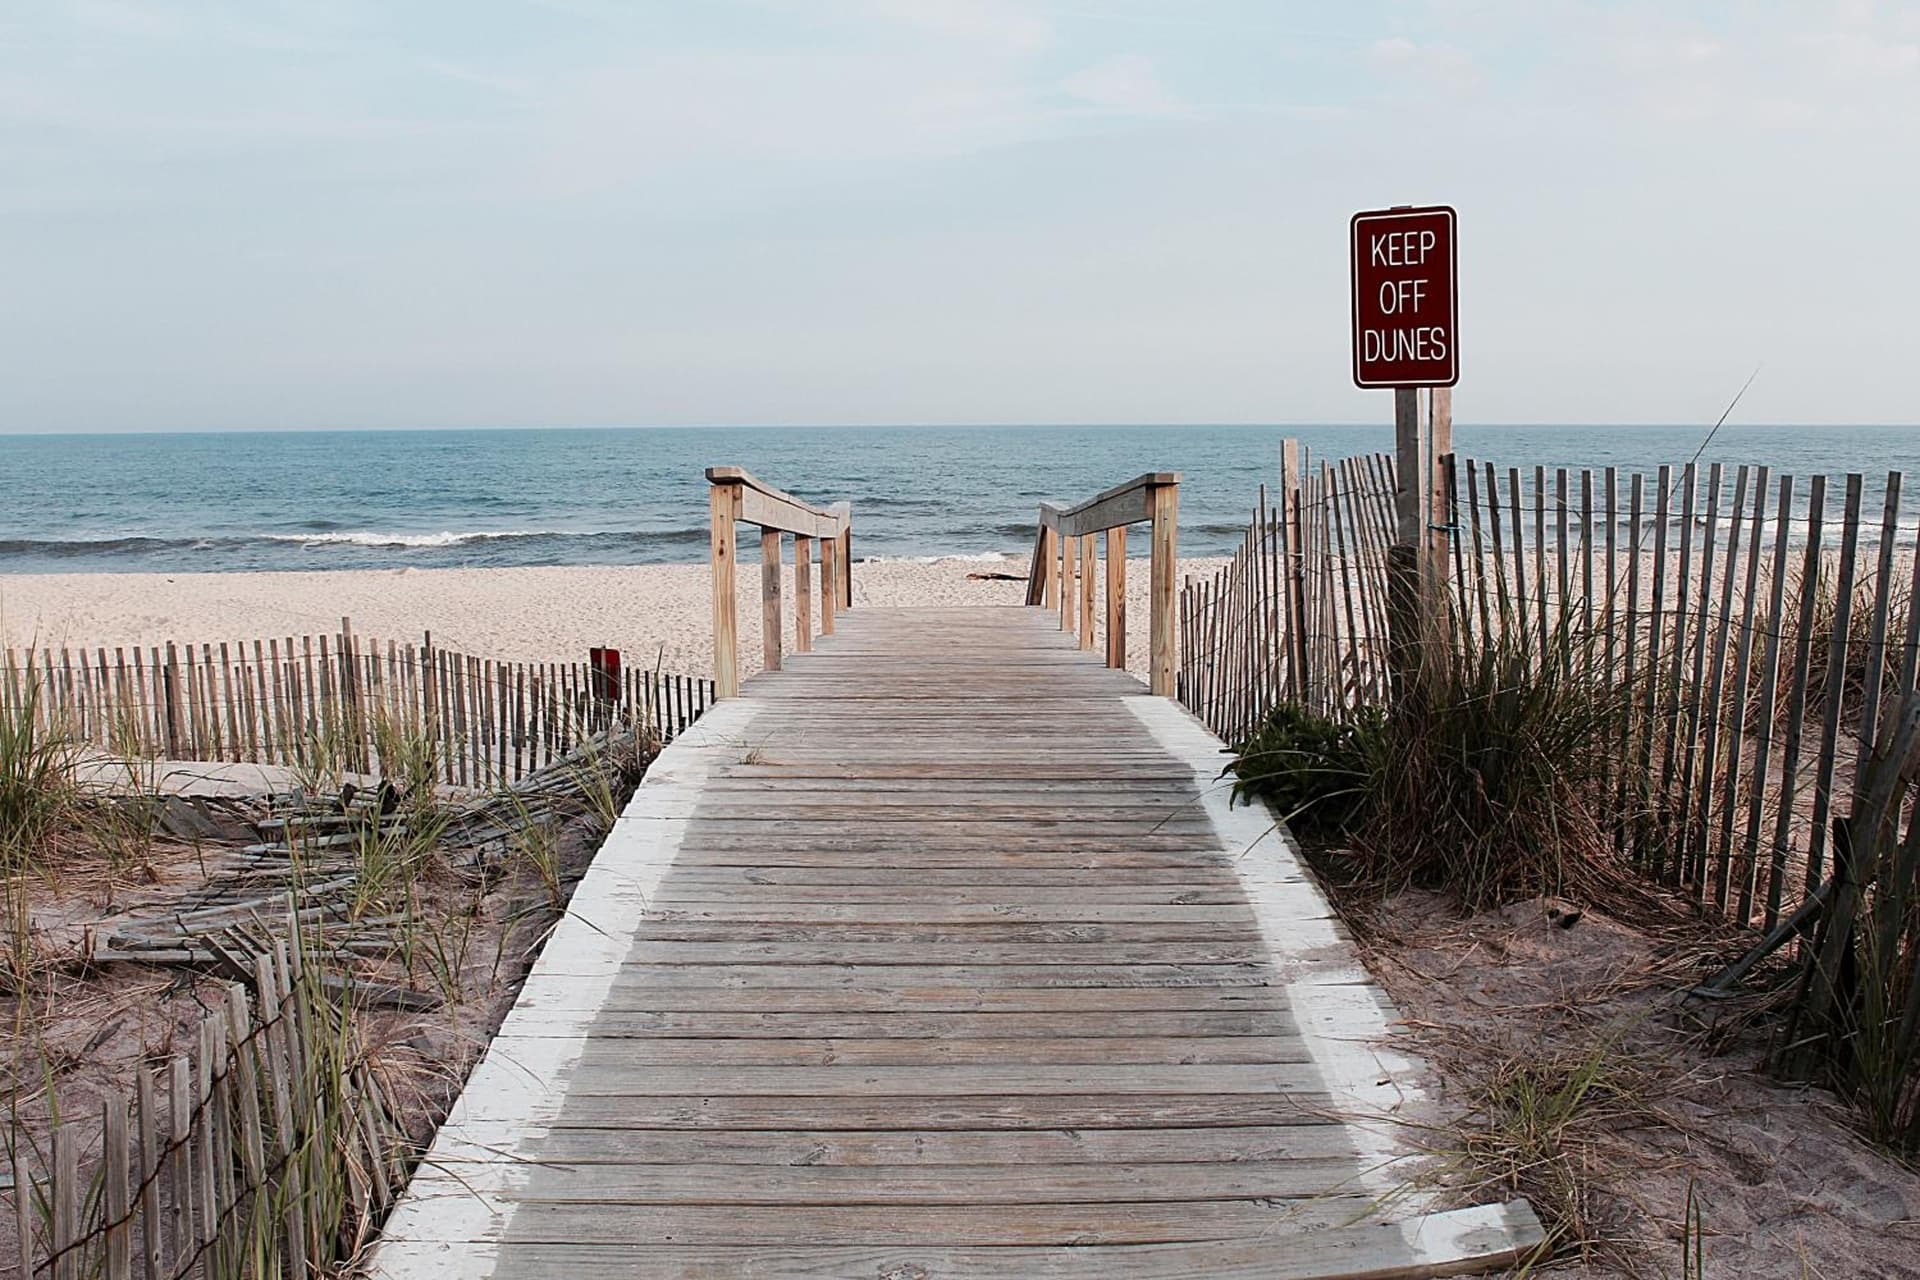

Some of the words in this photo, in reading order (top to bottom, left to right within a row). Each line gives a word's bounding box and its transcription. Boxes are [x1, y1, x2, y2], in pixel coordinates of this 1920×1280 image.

[1371, 231, 1436, 267] KEEP
[1379, 279, 1429, 315] OFF
[1364, 327, 1447, 362] DUNES
